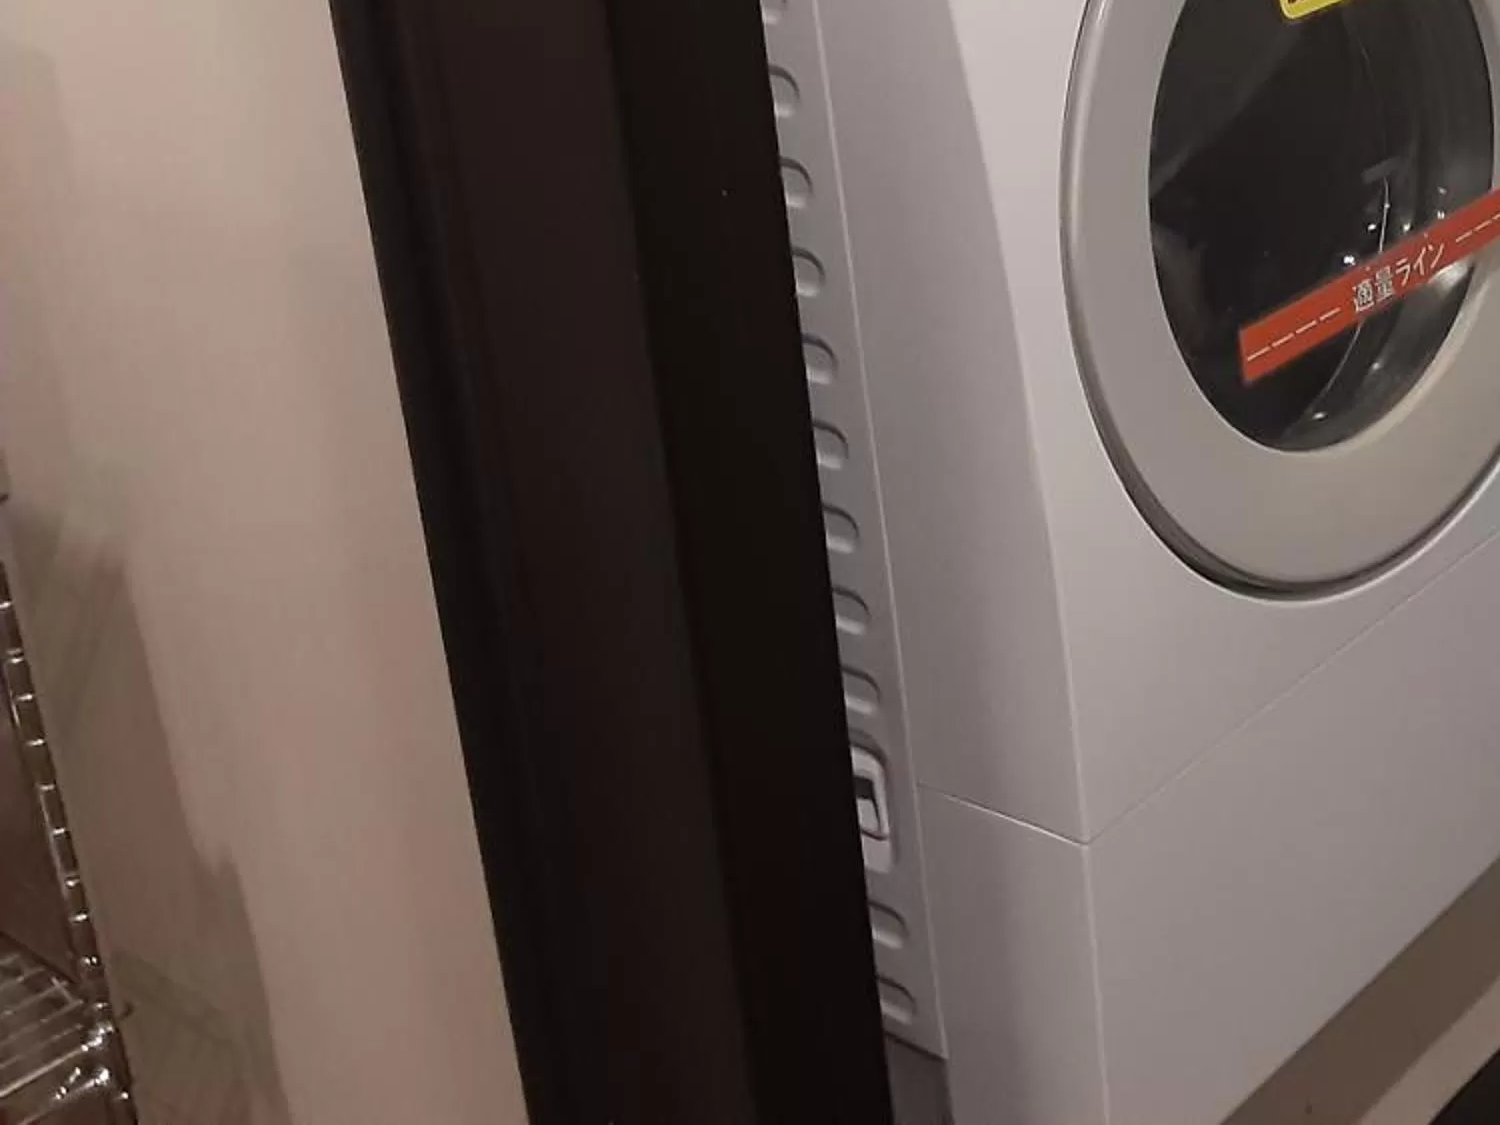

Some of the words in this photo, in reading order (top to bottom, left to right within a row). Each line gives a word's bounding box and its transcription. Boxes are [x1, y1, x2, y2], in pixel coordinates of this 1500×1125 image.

[1352, 242, 1445, 313] 適量ライン
